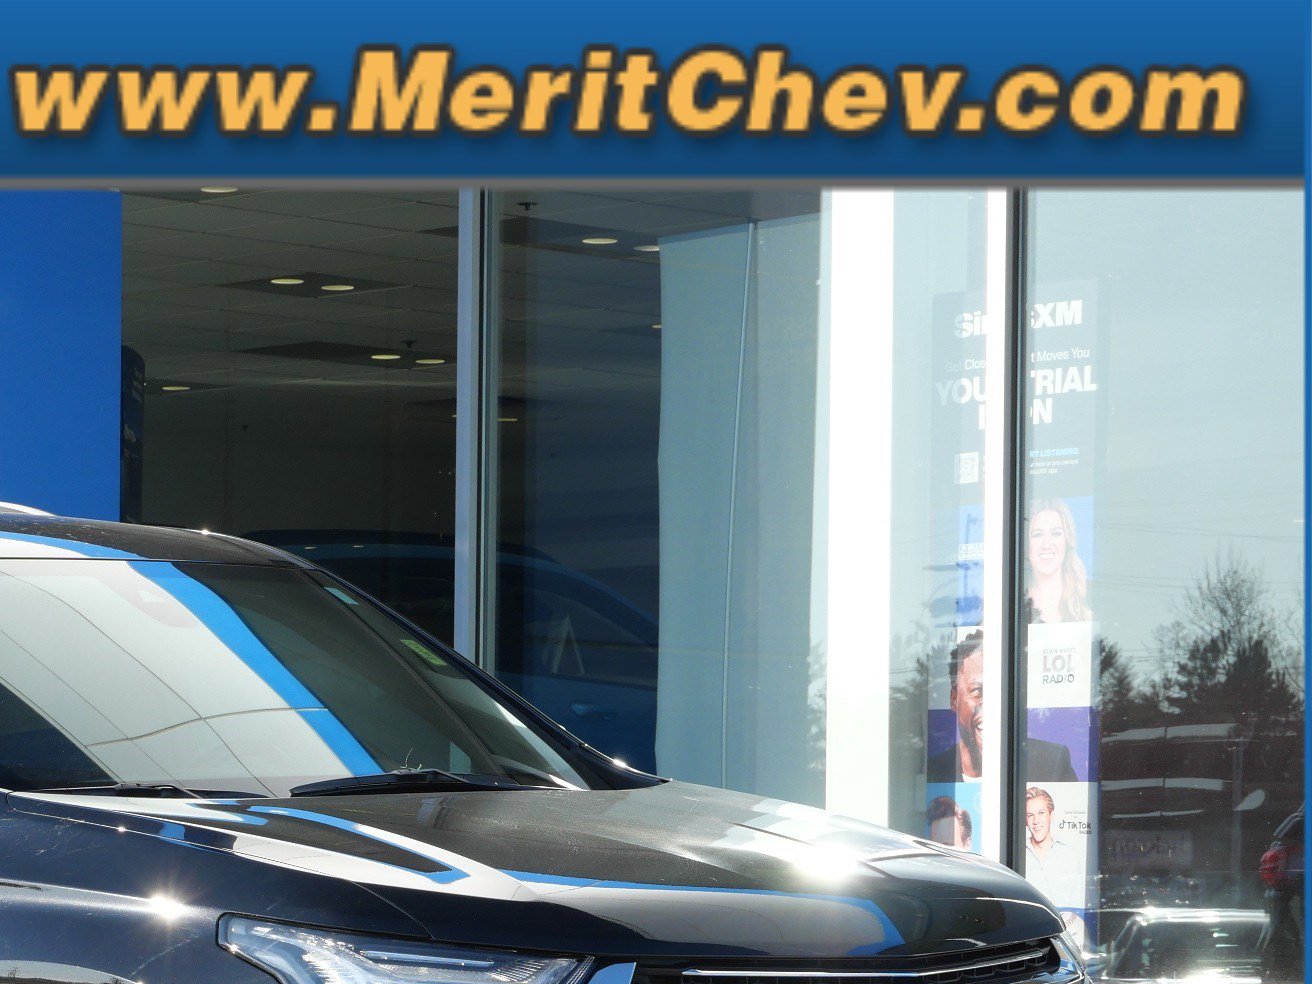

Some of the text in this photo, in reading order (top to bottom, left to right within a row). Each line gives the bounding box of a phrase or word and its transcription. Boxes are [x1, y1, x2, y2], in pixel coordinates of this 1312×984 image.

[1037, 351, 1069, 362] Moves
[1072, 347, 1090, 358] You
[934, 365, 1099, 406] YOU RIAL
[1043, 655, 1075, 673] LOL
